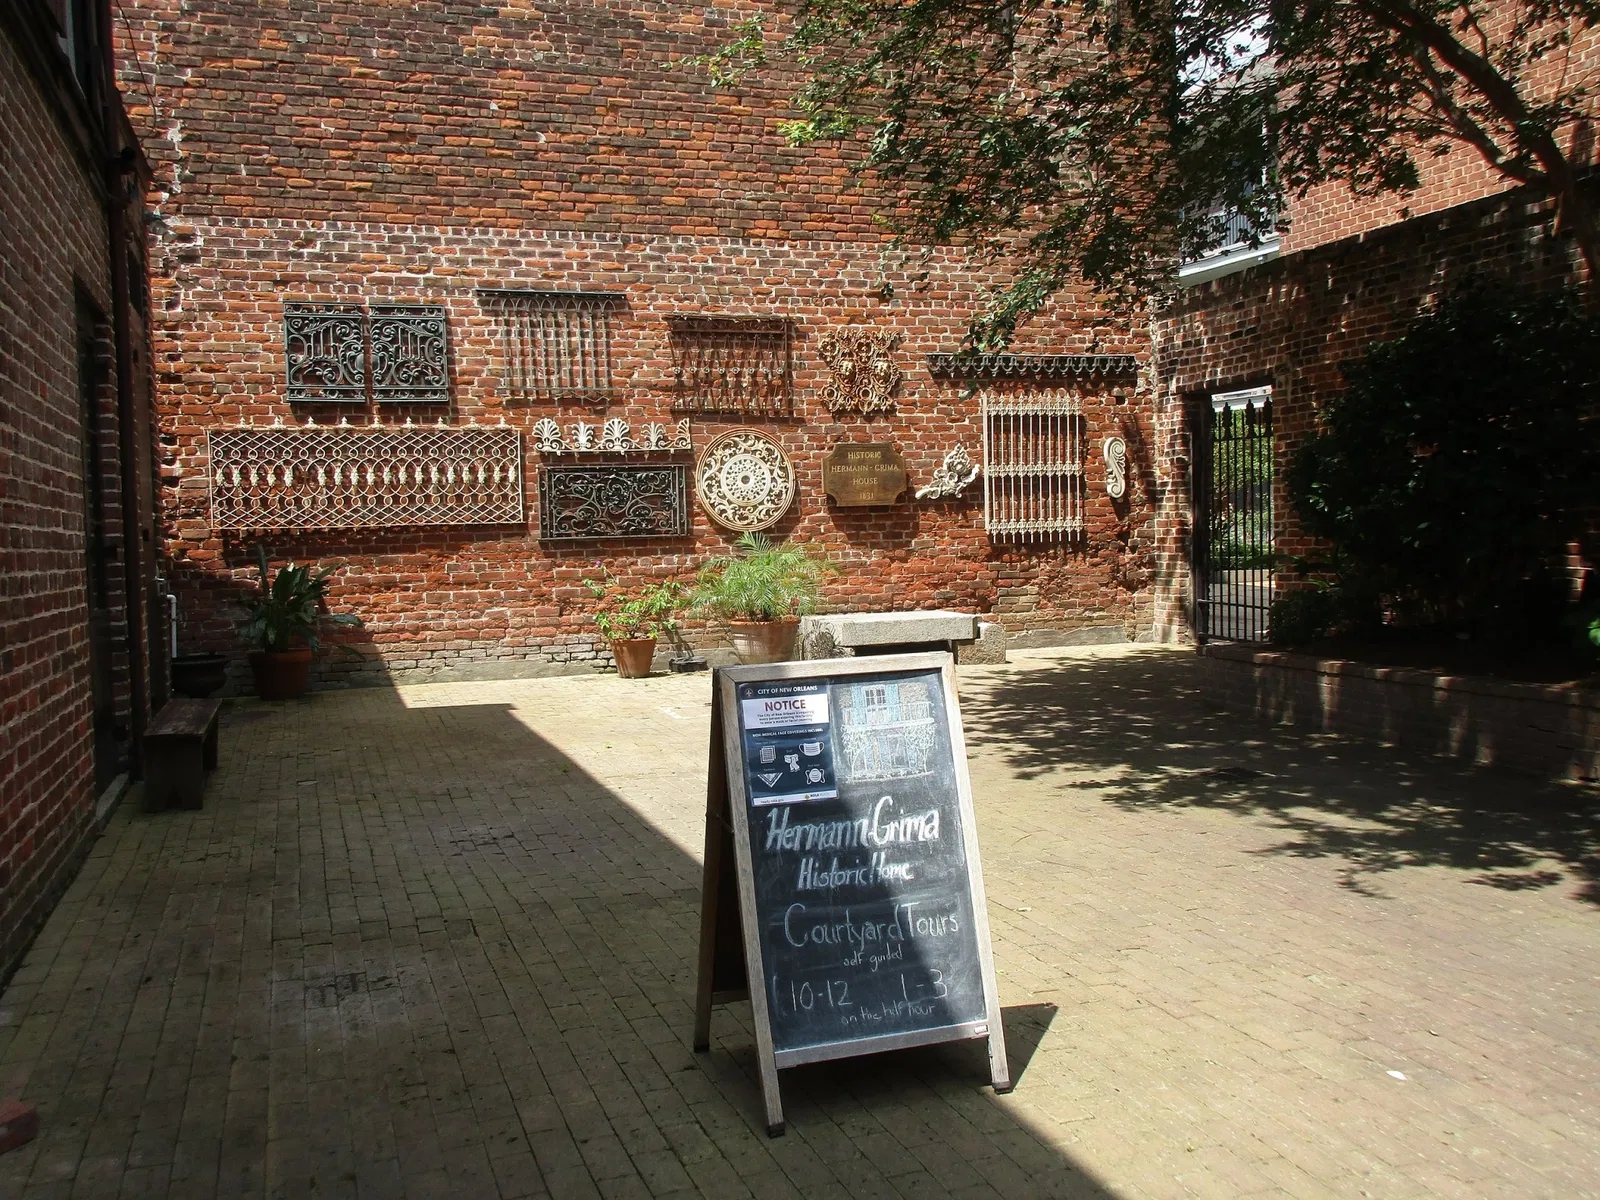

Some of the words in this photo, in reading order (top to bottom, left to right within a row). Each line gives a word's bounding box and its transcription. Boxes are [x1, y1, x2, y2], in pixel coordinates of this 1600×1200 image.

[765, 700, 806, 711] NOTICE
[765, 807, 868, 852] Hermann
[868, 796, 940, 845] Grima
[798, 858, 868, 891] Historic
[869, 851, 914, 883] Home
[784, 902, 903, 951] Courtyard
[902, 901, 959, 938] Tours
[843, 950, 864, 967] self
[870, 944, 902, 972] guided
[840, 1012, 857, 1024] on
[860, 1006, 882, 1020] the
[882, 1000, 904, 1016] half
[904, 1000, 936, 1017] hour
